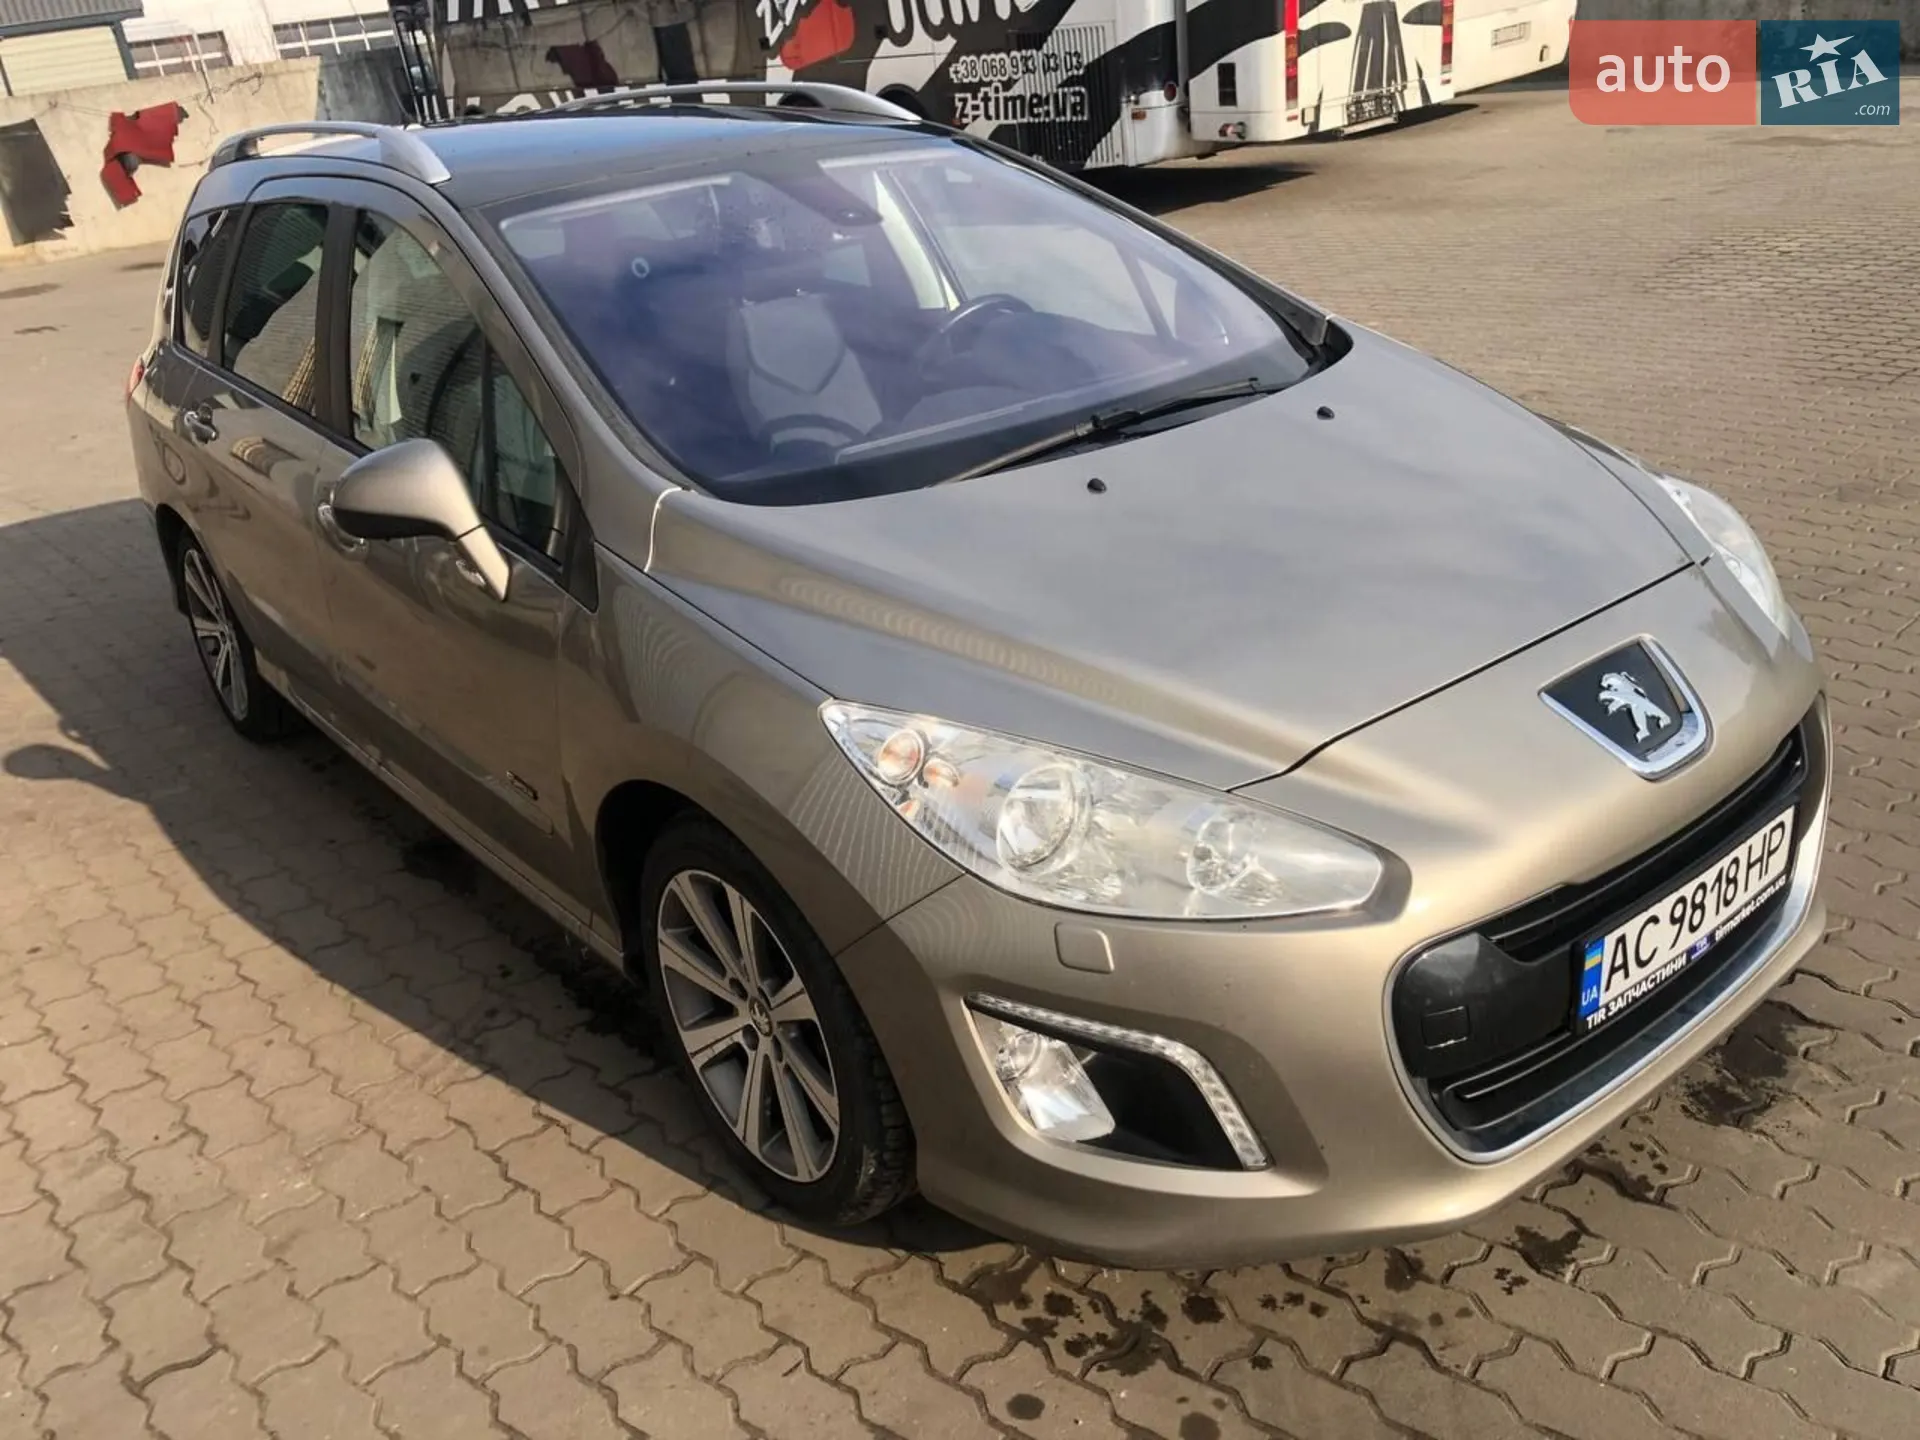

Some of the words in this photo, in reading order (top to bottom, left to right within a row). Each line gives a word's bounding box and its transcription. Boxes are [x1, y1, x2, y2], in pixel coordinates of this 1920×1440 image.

[951, 56, 979, 81] +38
[981, 55, 1008, 79] 068
[1010, 53, 1037, 76] 933
[1604, 915, 1660, 992] AC
[1669, 856, 1740, 950] 9818
[1744, 819, 1785, 892] HP
[1581, 985, 1599, 1007] UA
[1586, 1007, 1607, 1030] TIR
[1607, 951, 1687, 1017] ЗАПЧАСТИНИ
